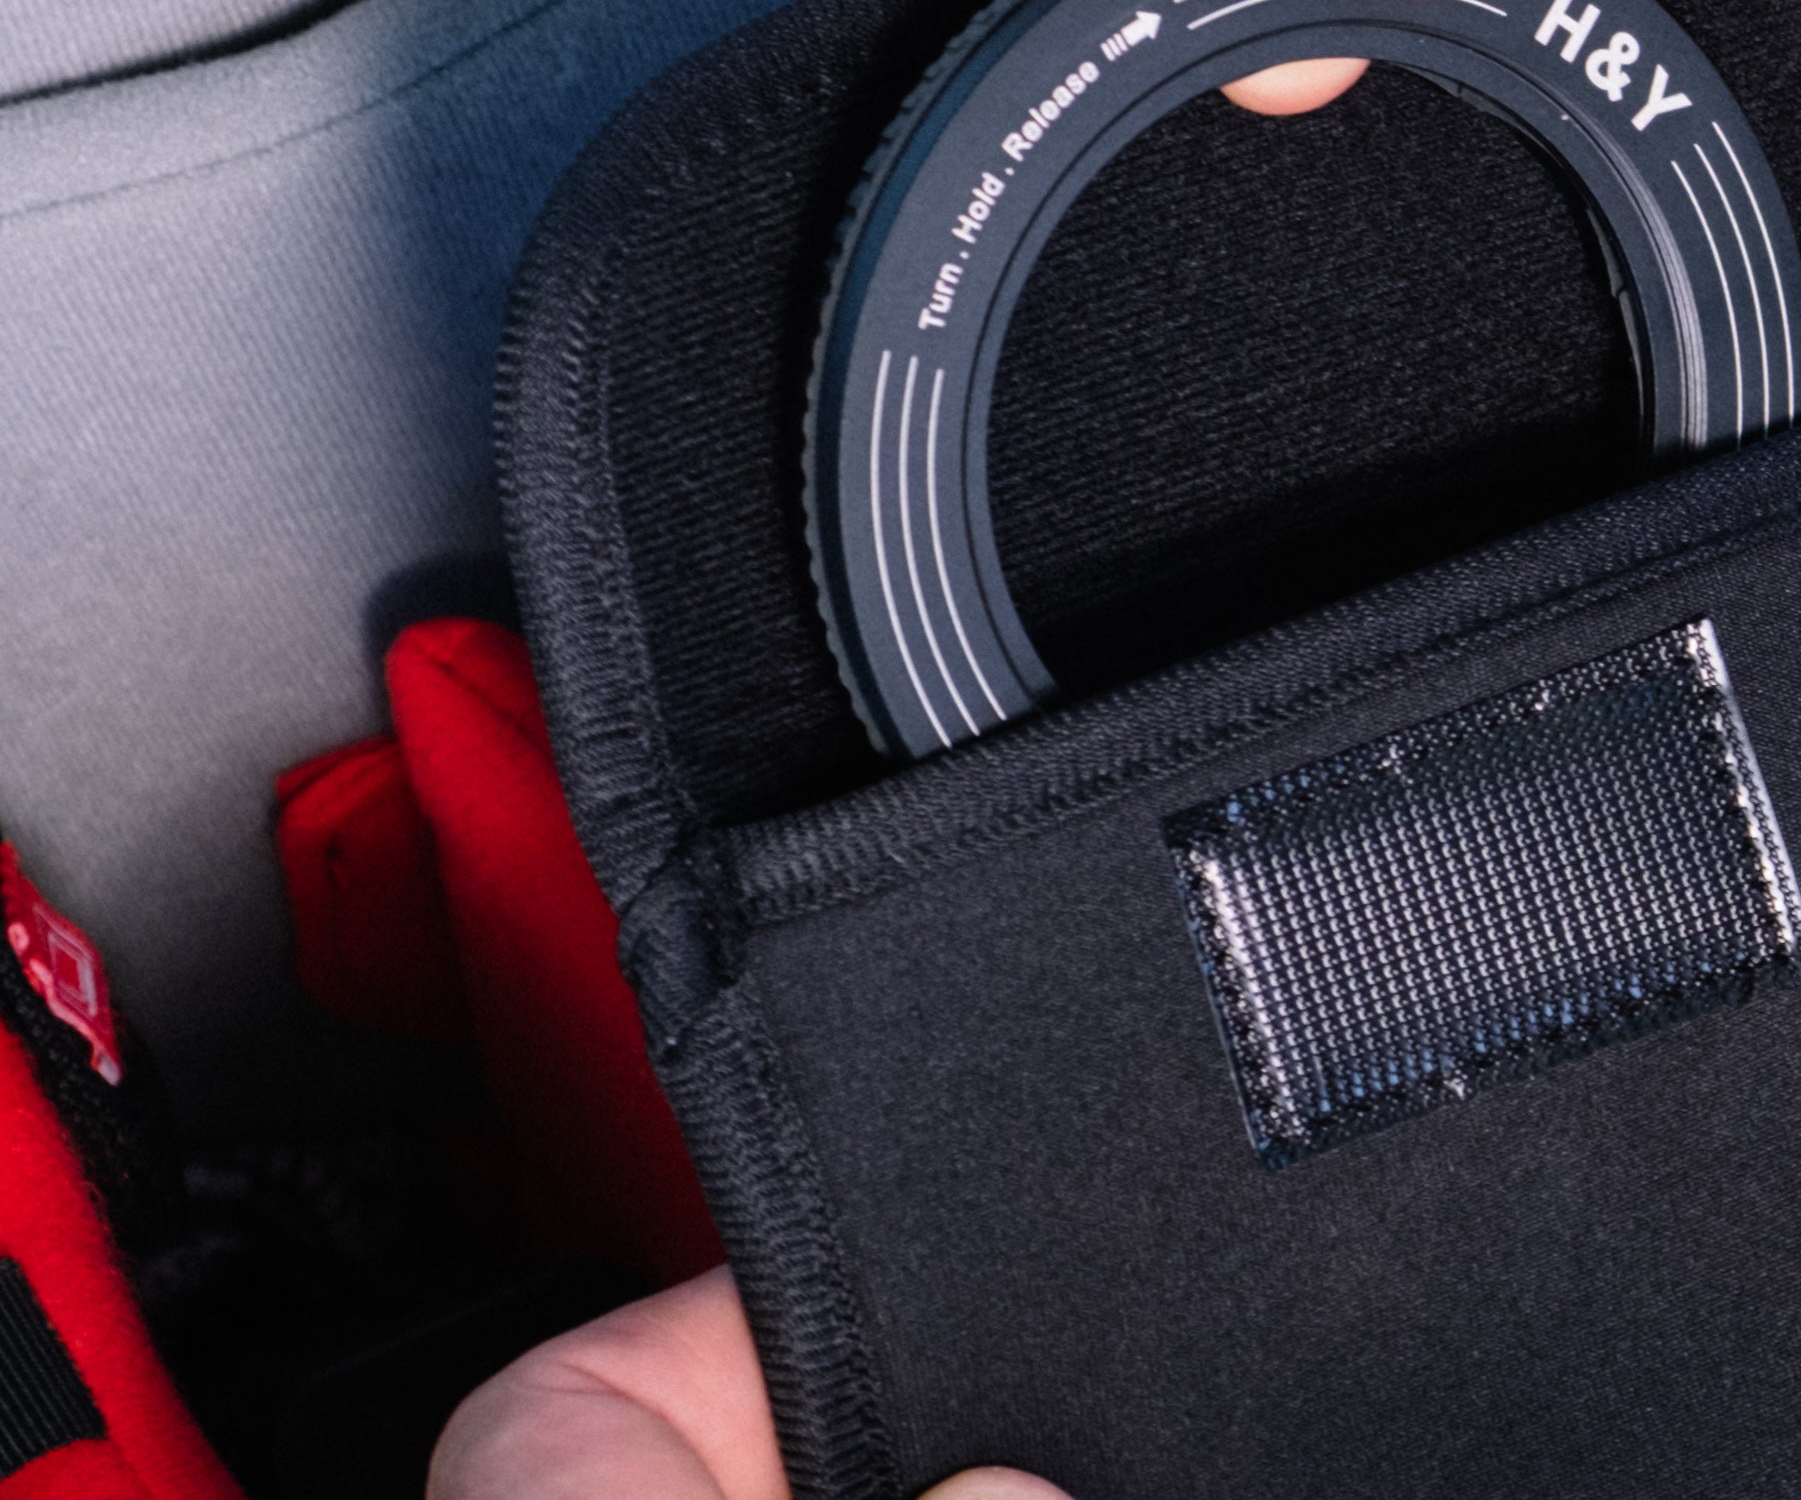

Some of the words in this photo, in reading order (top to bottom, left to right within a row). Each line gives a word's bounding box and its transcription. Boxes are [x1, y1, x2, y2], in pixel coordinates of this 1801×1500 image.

[917, 262, 964, 331] Turn
[951, 171, 1006, 244] Hold
[1001, 60, 1100, 162] Release
